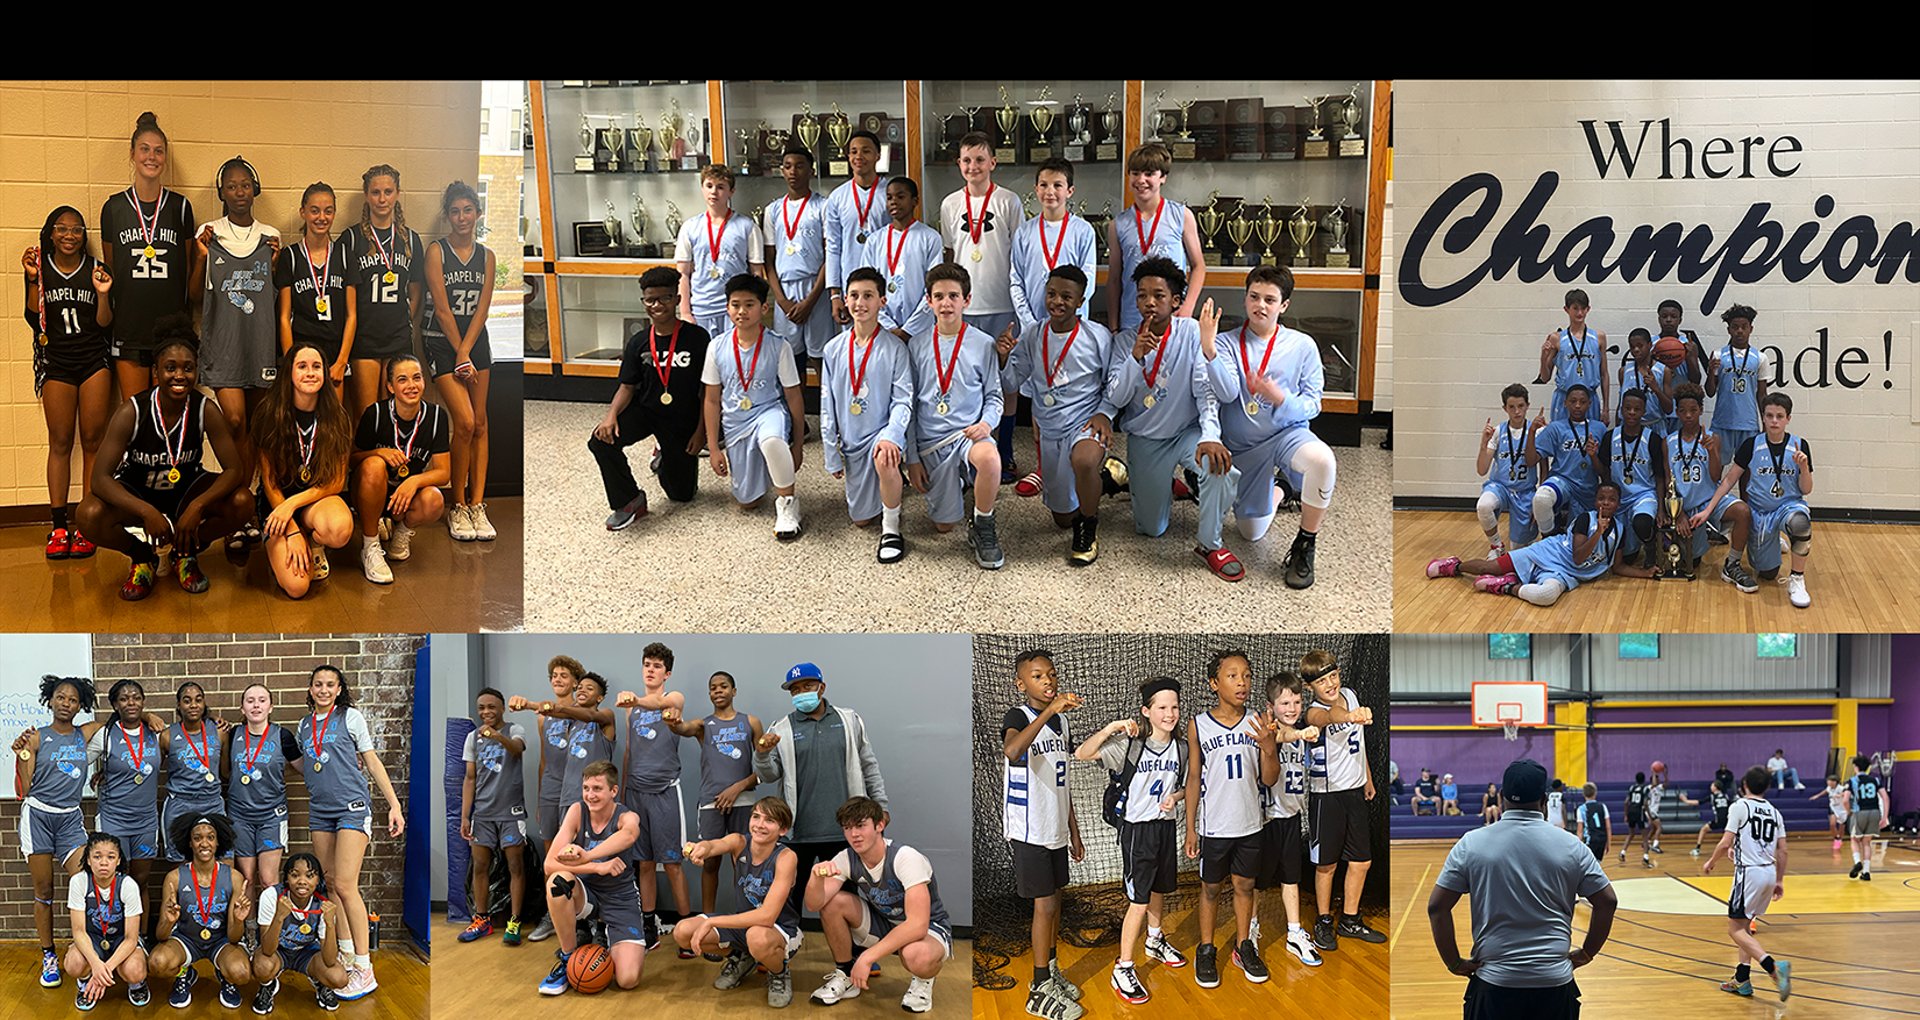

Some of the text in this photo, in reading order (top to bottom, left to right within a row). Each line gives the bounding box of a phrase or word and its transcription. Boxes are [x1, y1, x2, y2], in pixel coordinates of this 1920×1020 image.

[1577, 118, 1803, 180] Where
[159, 228, 178, 246] HILL
[131, 248, 169, 279] 35
[253, 260, 270, 276] 34
[394, 253, 412, 272] HILL
[45, 287, 75, 304] HAPEL
[220, 279, 265, 292] FLAMES
[370, 272, 399, 303] 12
[451, 289, 480, 316] 32
[60, 307, 82, 335] 11
[1031, 739, 1055, 757] BLUE
[1202, 732, 1260, 755] BLUE FLAME
[1346, 730, 1360, 755] 5
[1055, 760, 1067, 787] 2
[1136, 758, 1154, 773] LUE
[1225, 753, 1244, 780] 11
[1149, 778, 1164, 804] 4
[1631, 792, 1642, 804] 10
[1859, 782, 1877, 800] 13
[1592, 812, 1601, 828] 1
[1750, 815, 1776, 843] 00
